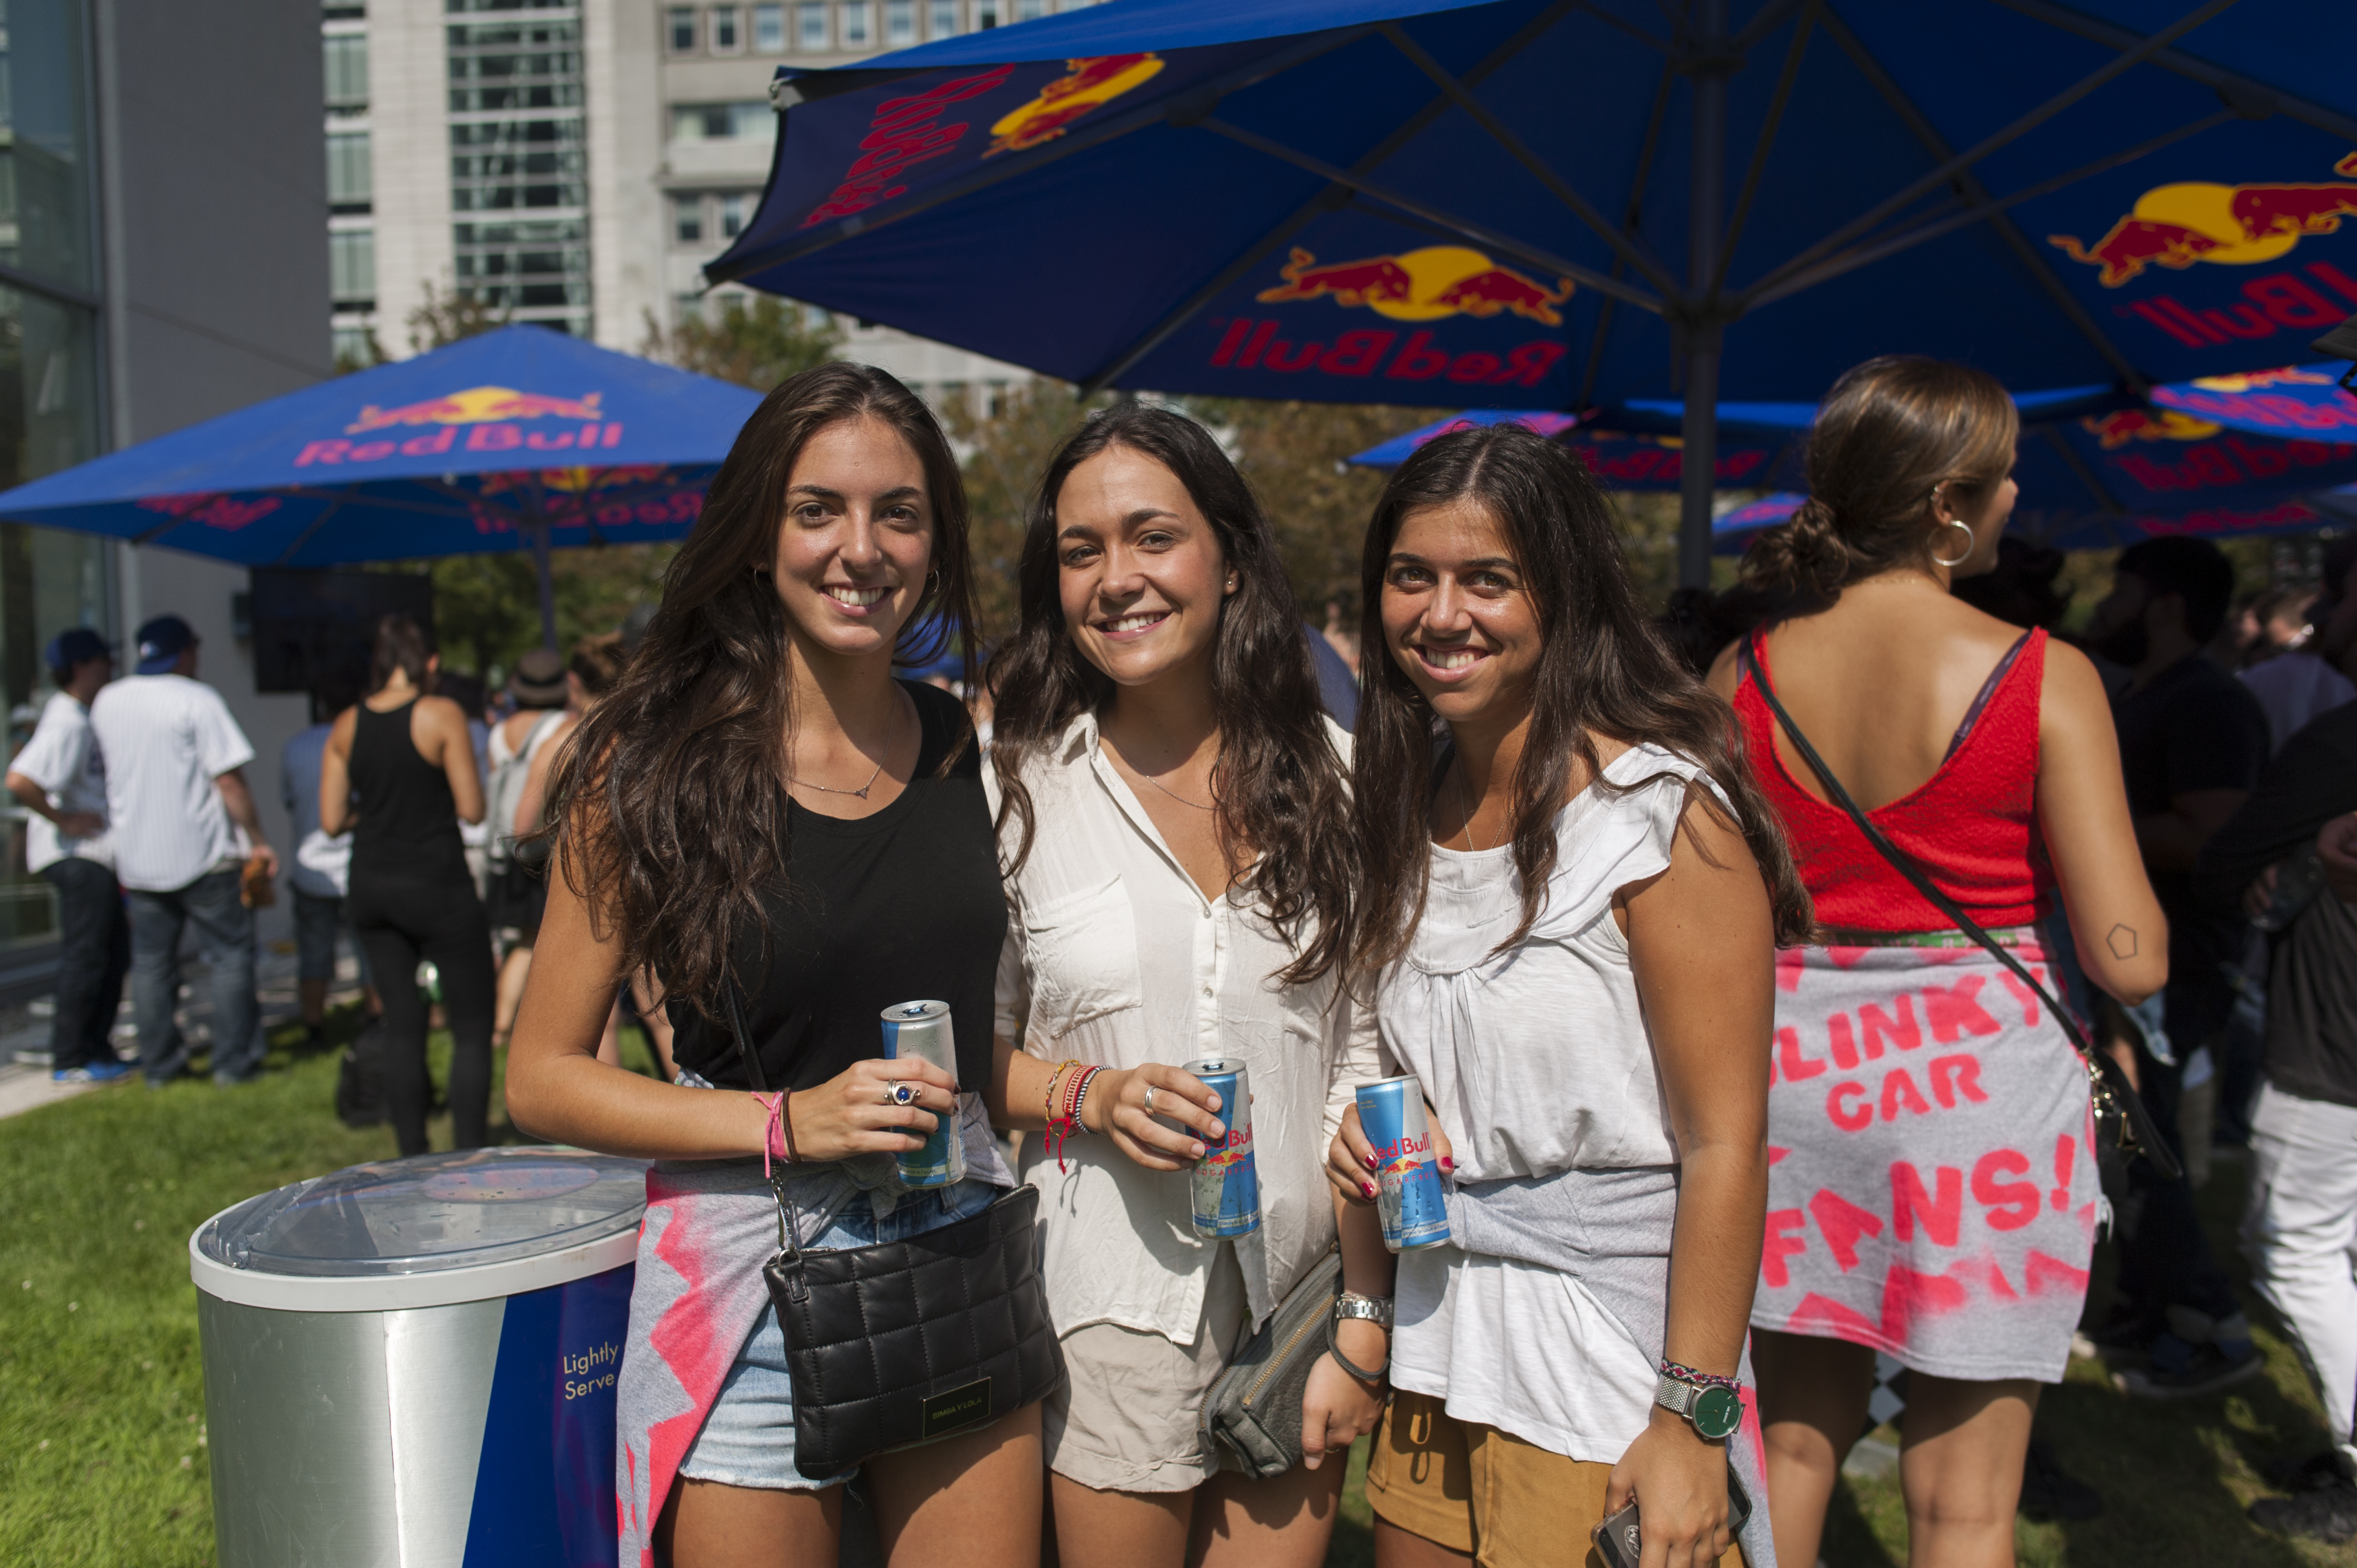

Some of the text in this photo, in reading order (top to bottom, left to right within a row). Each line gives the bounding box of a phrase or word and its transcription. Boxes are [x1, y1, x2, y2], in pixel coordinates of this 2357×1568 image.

[292, 421, 624, 468] Red Bull
[1768, 968, 2045, 1091] LINKY
[1826, 1053, 1989, 1133] CAR
[1228, 1121, 1253, 1148] Bull
[1370, 1132, 1430, 1160] ed Bull
[1196, 1161, 1253, 1177] SUGARFREE
[1377, 1170, 1434, 1187] SUGARFREE
[1762, 1133, 2075, 1288] FANS!
[564, 1341, 619, 1375] Lightly
[565, 1373, 615, 1400] Serve
[932, 1406, 956, 1420] BIMBA
[963, 1397, 982, 1409] LOLA
